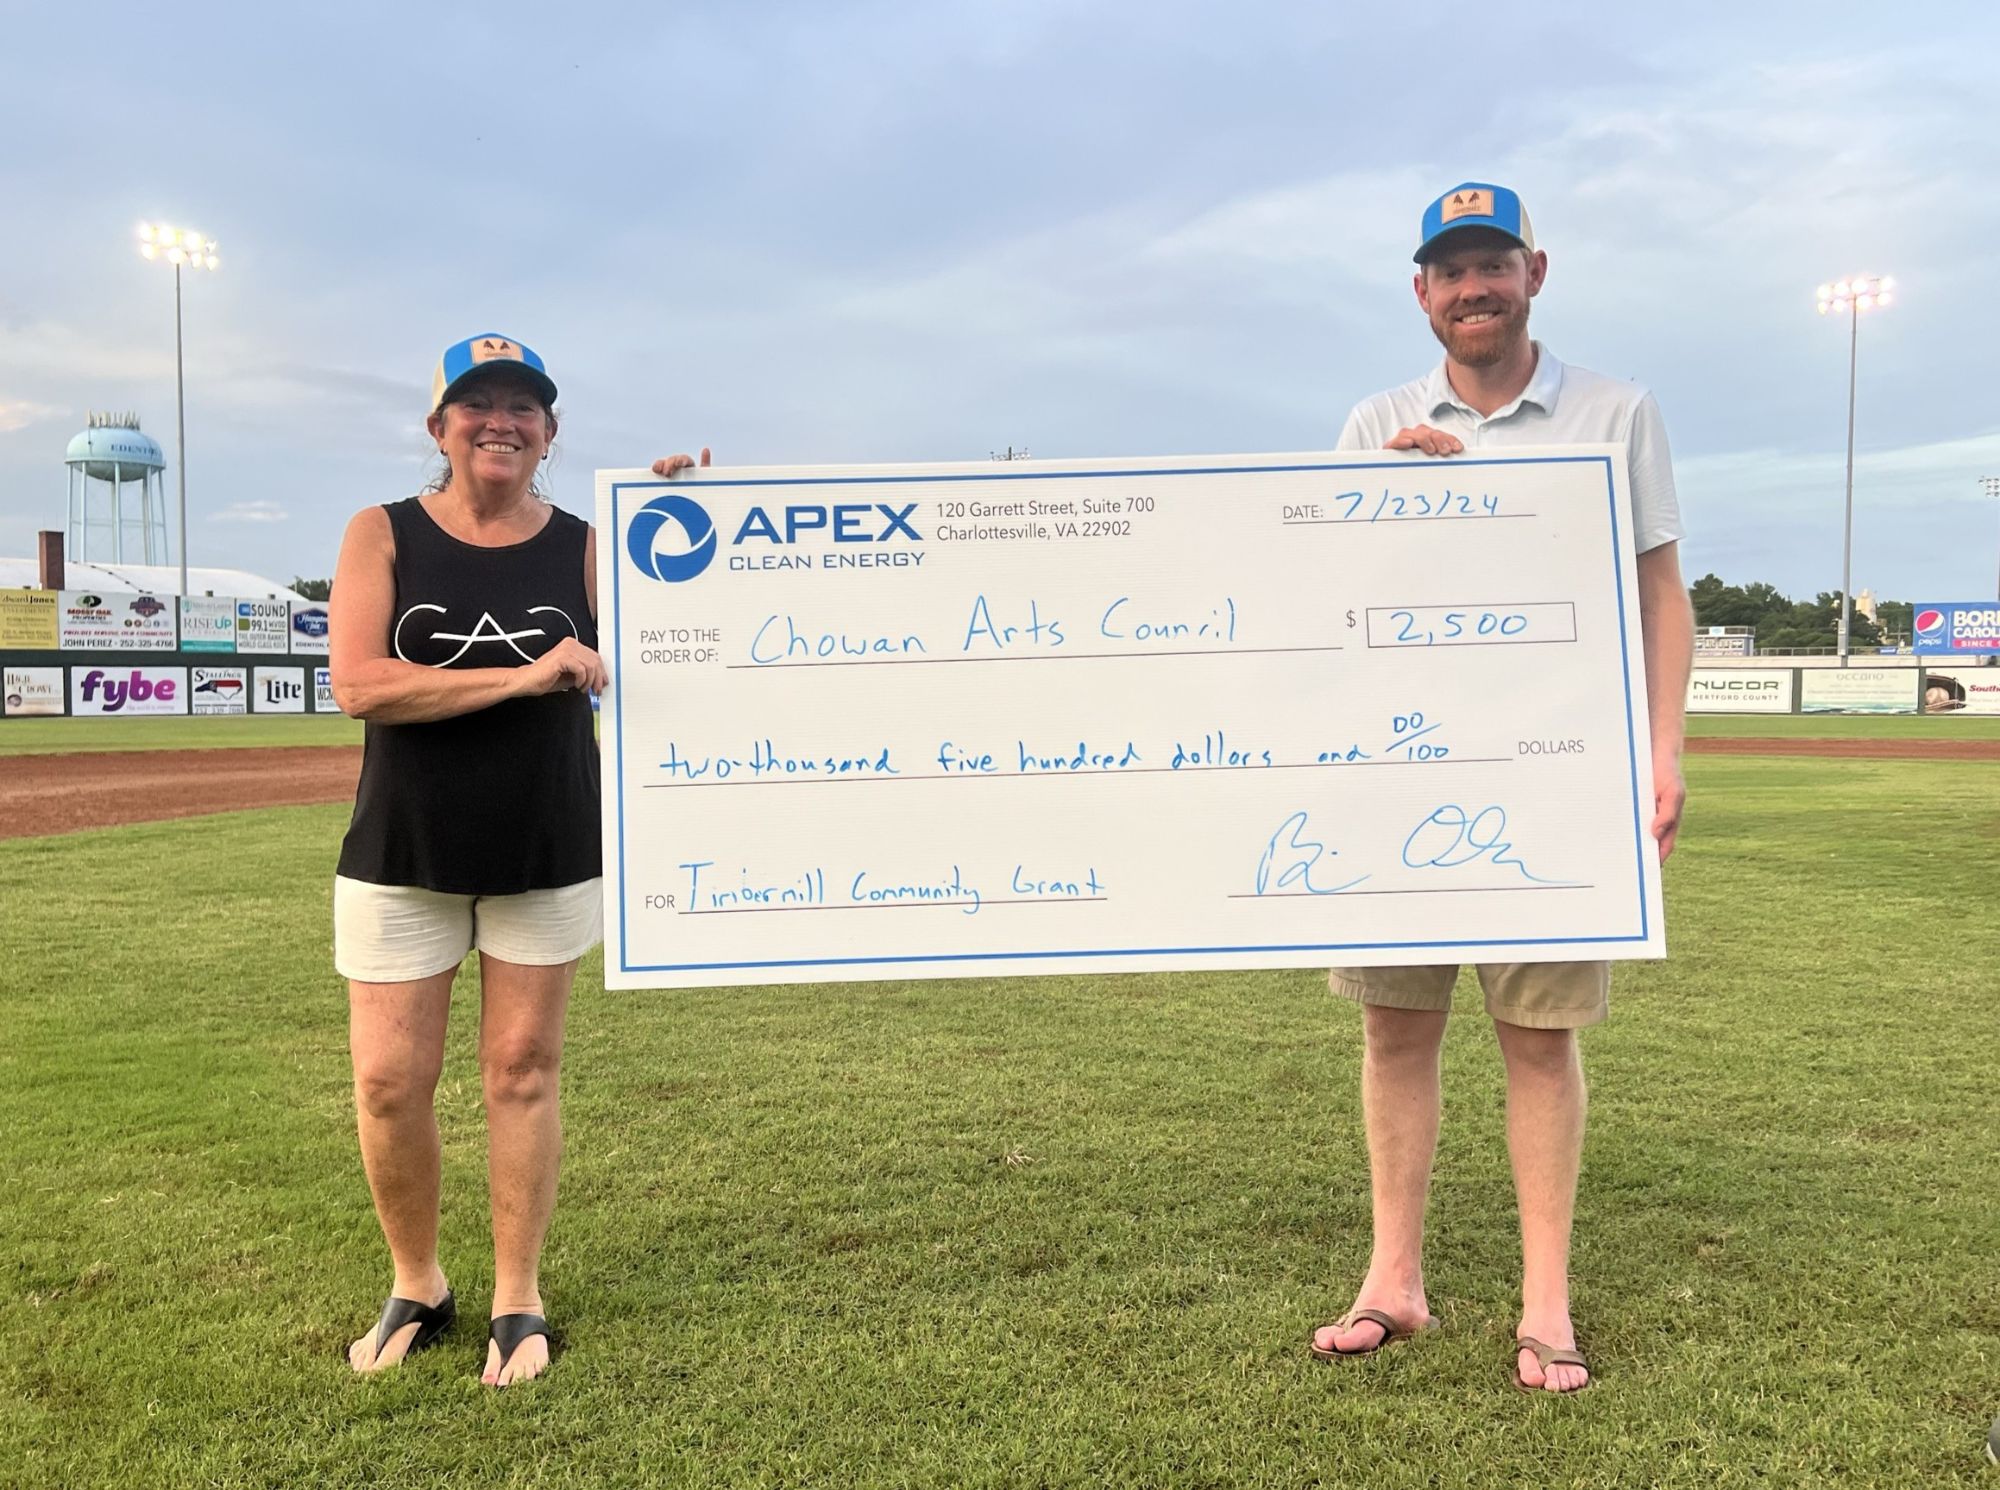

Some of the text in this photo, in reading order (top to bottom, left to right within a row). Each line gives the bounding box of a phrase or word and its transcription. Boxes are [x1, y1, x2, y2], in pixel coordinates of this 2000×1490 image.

[936, 497, 1155, 518] 120 Garrett Street, Suite 700
[1282, 505, 1324, 520] DATE:
[1335, 489, 1498, 524] 7/23/24
[732, 503, 924, 545] APEX
[937, 521, 1131, 541] Charlottesville, VA 22902
[729, 552, 925, 571] CLEAN ENERGY
[251, 604, 286, 617] SOUND
[1346, 609, 1356, 628] $
[251, 620, 268, 632] 99.1
[751, 615, 926, 663] Chowan
[963, 595, 1064, 651] Arts
[1390, 611, 1527, 646] 2,500
[1953, 627, 2000, 638] CAROL
[63, 639, 85, 647] JOHN
[87, 639, 112, 647] PEREZ
[640, 629, 720, 643] PAY TO THE
[641, 649, 719, 663] ORDER OF:
[81, 670, 176, 712] fybe
[266, 680, 302, 704] Lite
[1694, 681, 1779, 690] NUCOR
[938, 742, 999, 772] five
[1019, 741, 1142, 772] hundred
[1317, 745, 1372, 762] and
[1518, 740, 1585, 755] DOLLARS
[852, 865, 980, 914] Community
[1013, 865, 1105, 895] Grant
[646, 895, 675, 908] FOR
